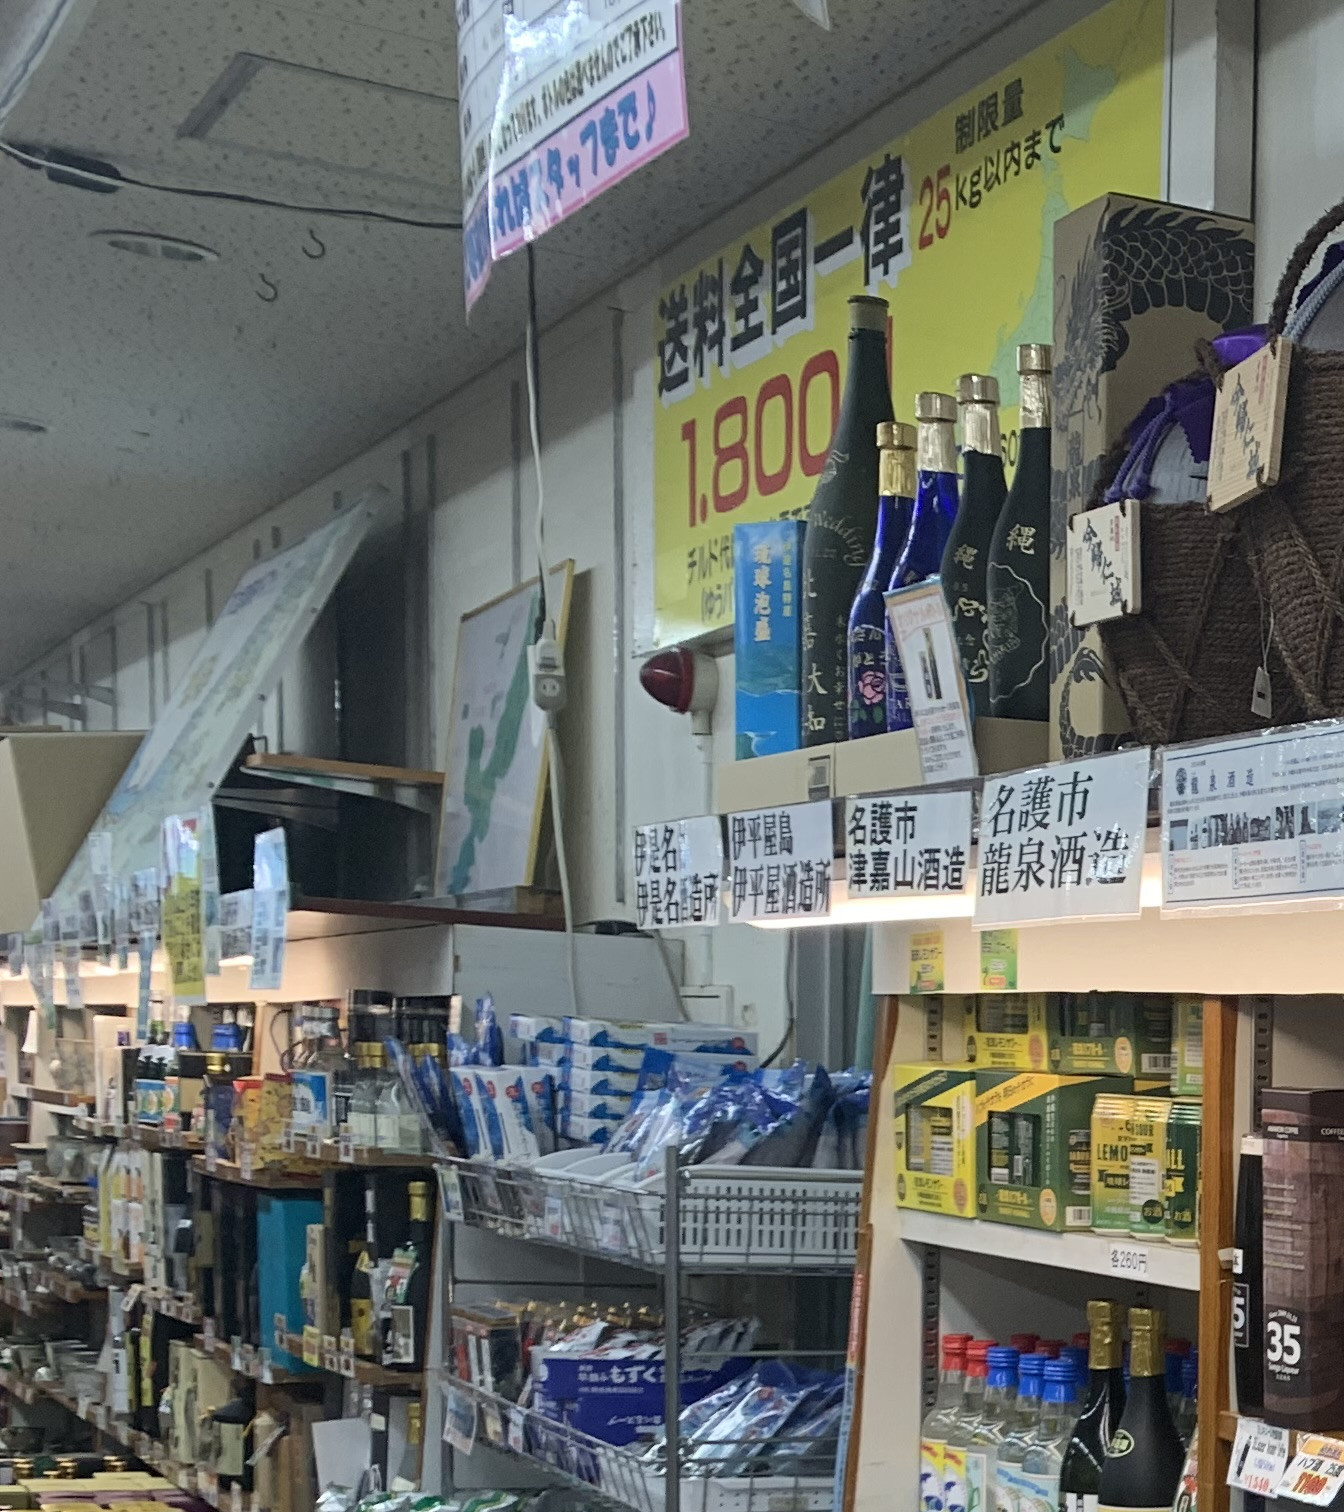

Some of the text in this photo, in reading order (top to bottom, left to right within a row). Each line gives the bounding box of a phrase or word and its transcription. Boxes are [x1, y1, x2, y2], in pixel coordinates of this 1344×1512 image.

[954, 79, 1024, 156] 制限量
[657, 153, 905, 398] 送料全国一律
[848, 801, 919, 846] 名護市
[987, 771, 1094, 838] 名護市
[848, 849, 966, 893] 津嘉山酒造
[1266, 1320, 1302, 1367] 35
